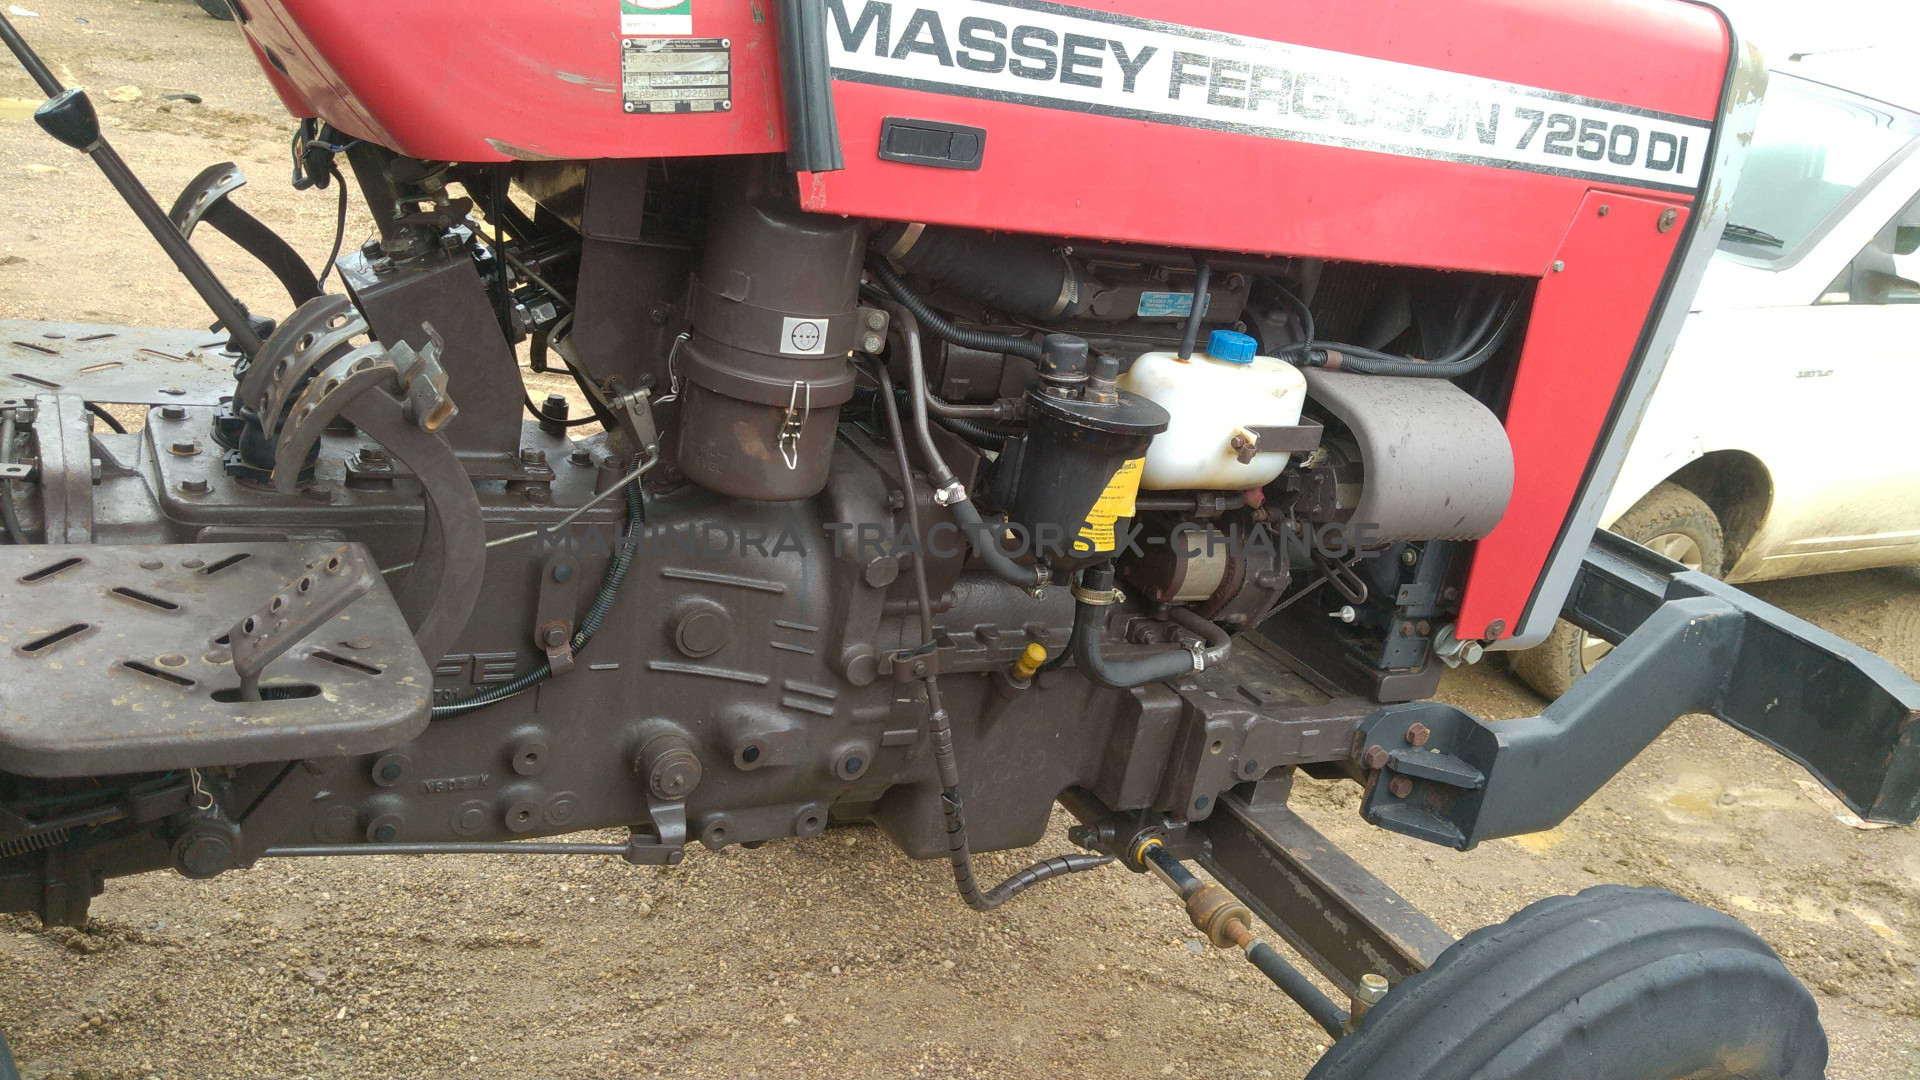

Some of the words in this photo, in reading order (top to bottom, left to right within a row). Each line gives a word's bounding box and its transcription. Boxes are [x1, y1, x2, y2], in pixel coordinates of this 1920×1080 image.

[827, 0, 1157, 93] MASSEY
[1168, 50, 1500, 145] FERGUSON
[1514, 107, 1640, 166] 7250
[1646, 130, 1689, 174] DI
